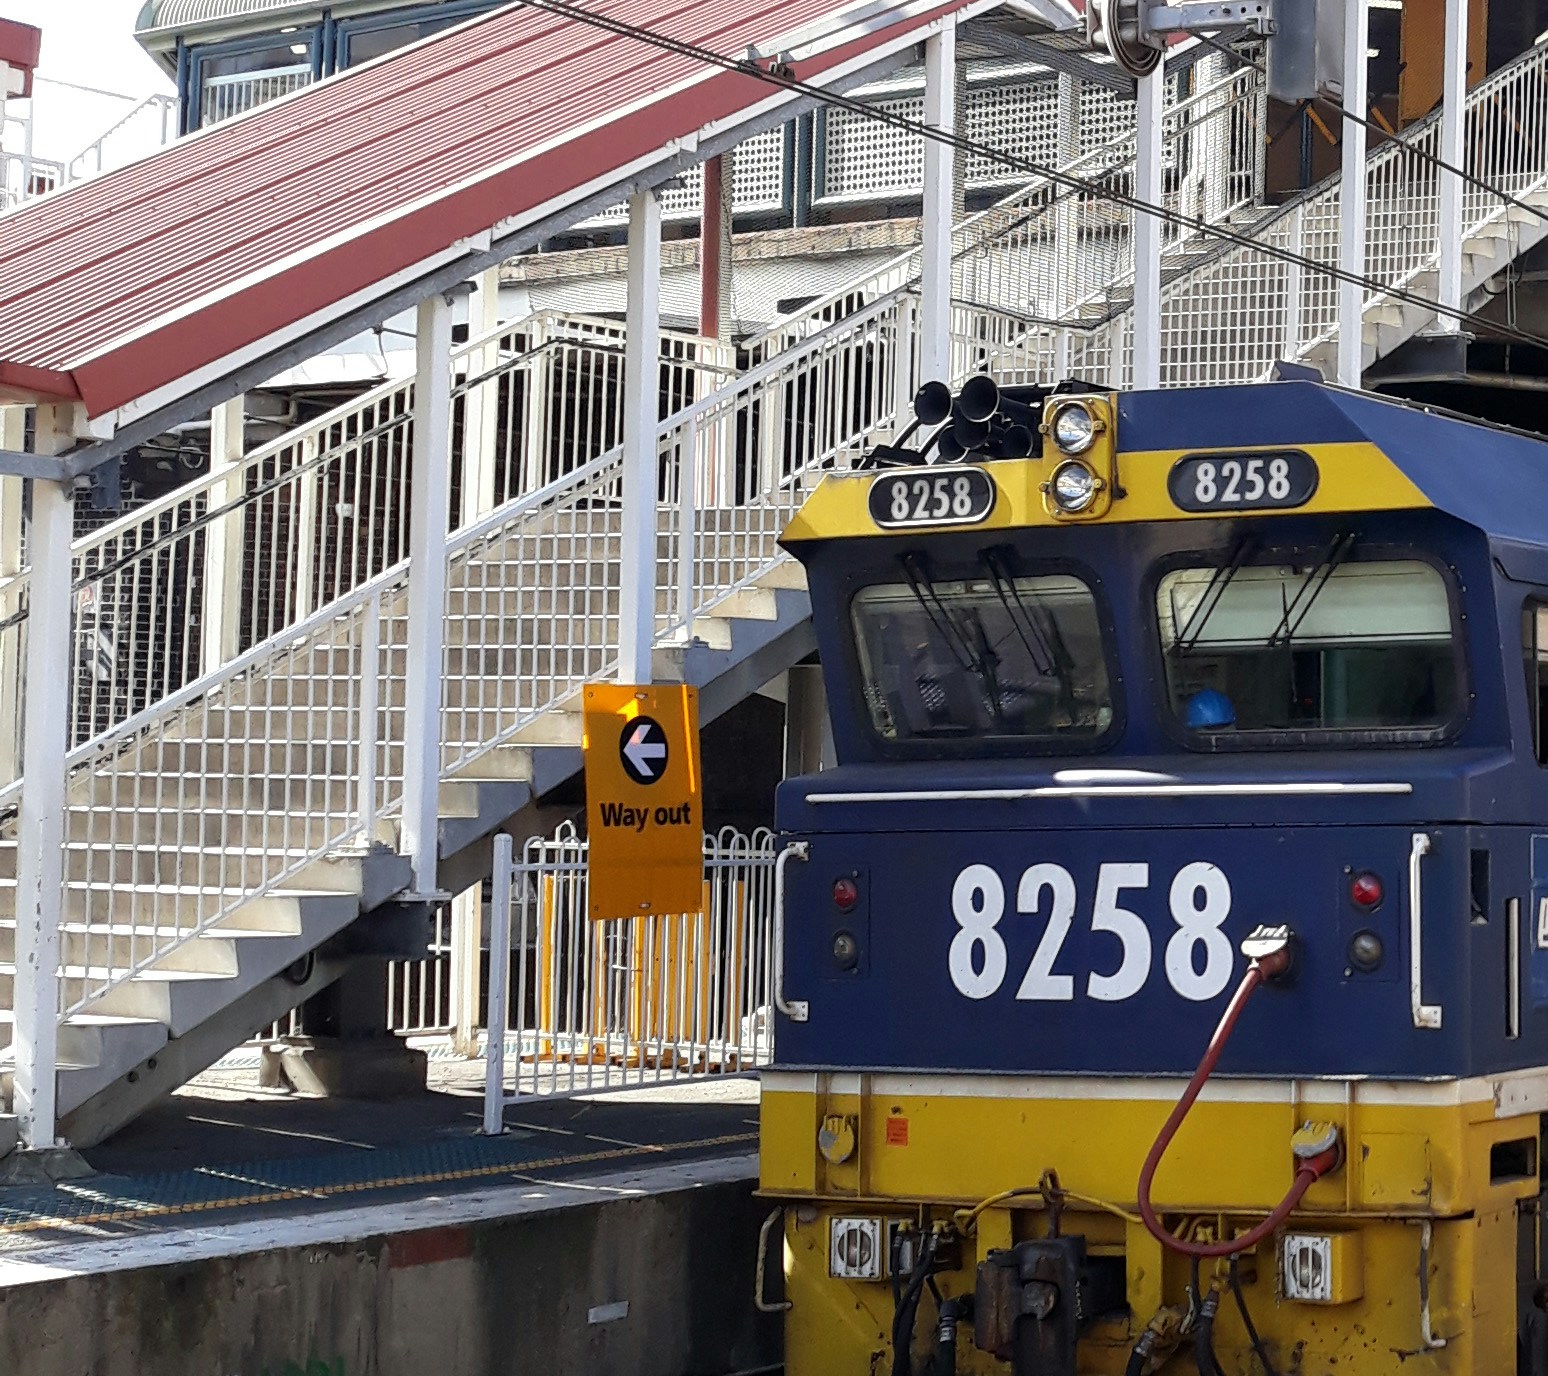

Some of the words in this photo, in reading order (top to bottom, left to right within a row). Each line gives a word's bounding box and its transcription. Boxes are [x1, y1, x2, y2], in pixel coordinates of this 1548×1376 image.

[890, 476, 973, 520] 8258
[1194, 458, 1292, 503] 8258
[600, 802, 650, 833] Way
[654, 802, 691, 826] out
[948, 861, 1234, 1001] 8258
